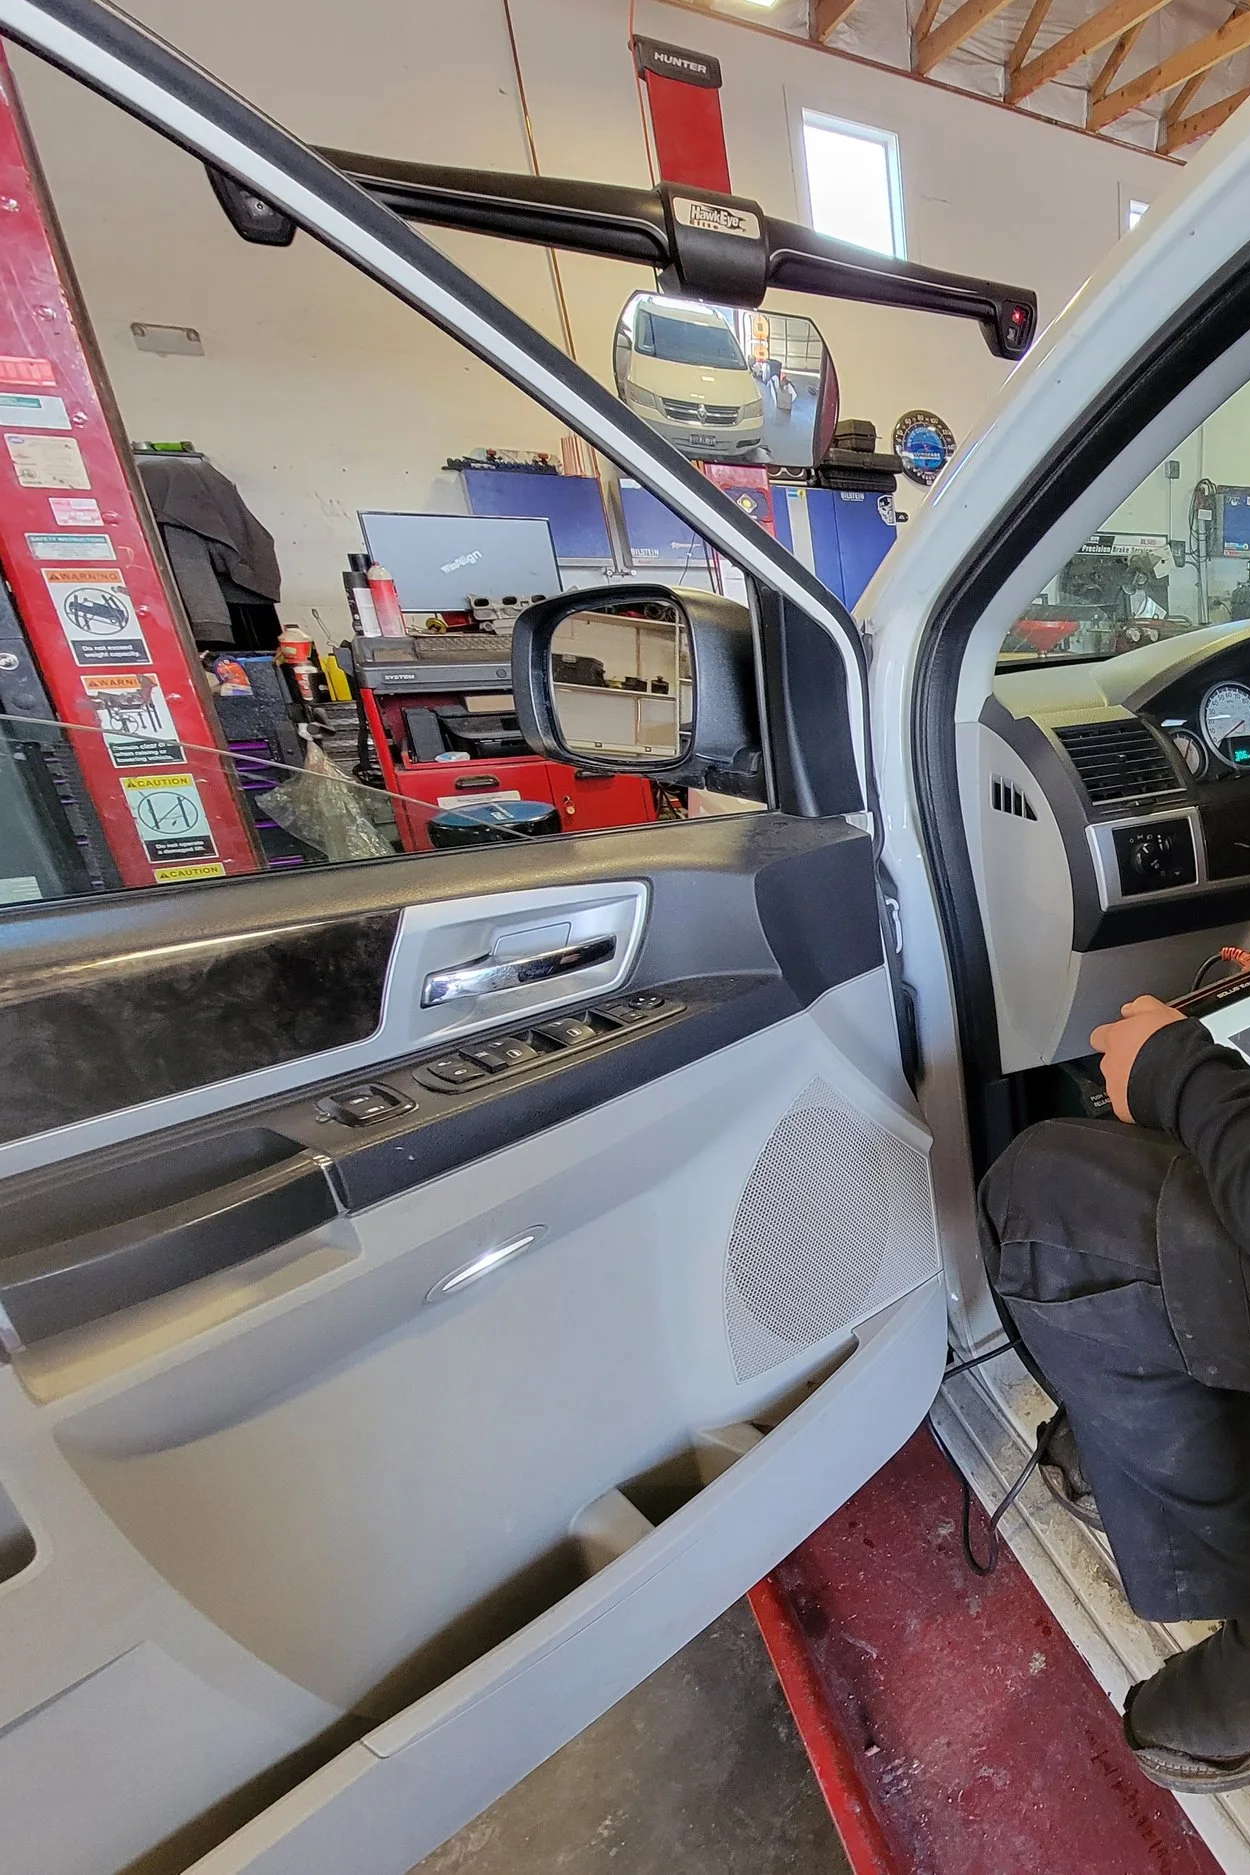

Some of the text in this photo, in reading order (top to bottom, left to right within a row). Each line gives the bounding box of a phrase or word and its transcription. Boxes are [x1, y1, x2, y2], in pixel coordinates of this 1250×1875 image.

[654, 51, 707, 74] HUNTER
[690, 204, 740, 227] HawkEye
[630, 548, 660, 557] BILSTEIN
[1082, 544, 1111, 553] Precision
[1113, 545, 1130, 554] Brake
[60, 572, 119, 581] WARNING
[84, 651, 110, 659] weight
[99, 678, 140, 687] WARNI
[137, 777, 189, 788] CAUTION
[178, 841, 205, 849] operate
[169, 866, 219, 879] CAUTION
